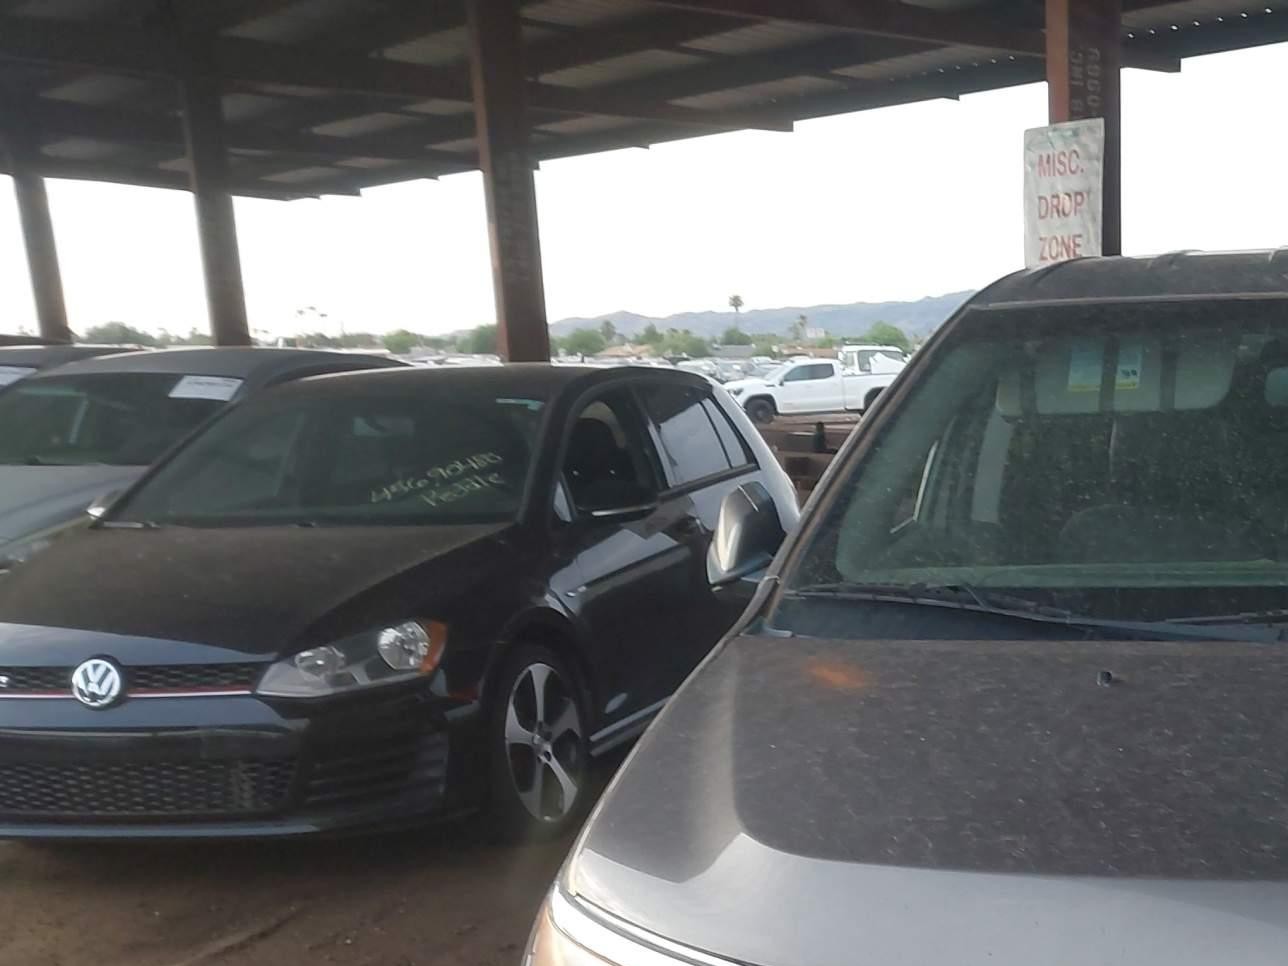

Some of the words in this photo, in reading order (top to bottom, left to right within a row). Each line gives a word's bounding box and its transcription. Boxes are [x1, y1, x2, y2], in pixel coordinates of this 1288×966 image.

[1038, 149, 1084, 177] MISC.
[1038, 191, 1085, 219] DROP
[1039, 234, 1082, 261] ZONE
